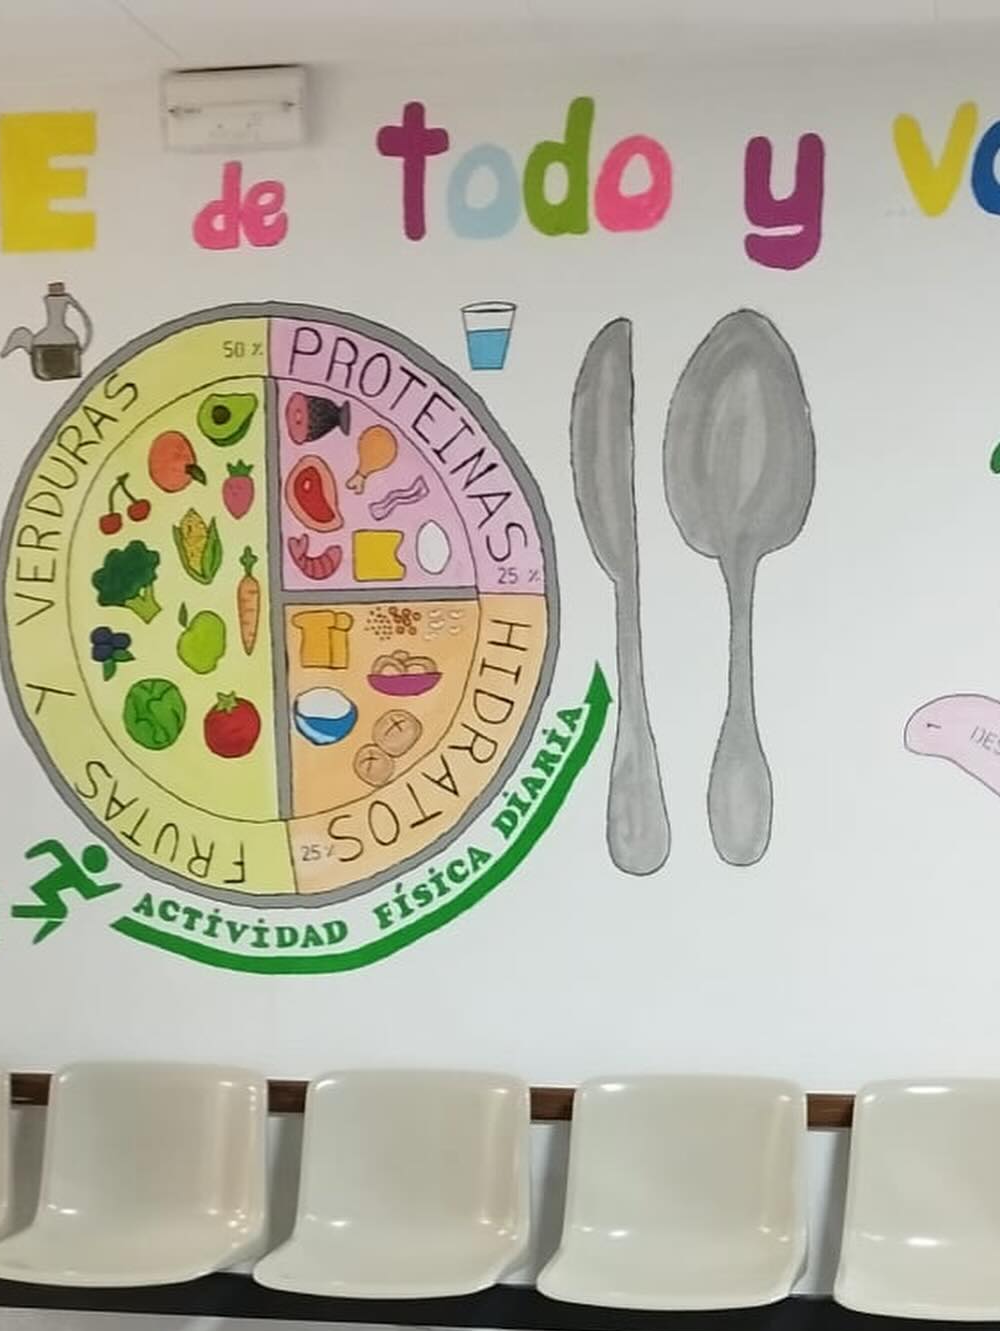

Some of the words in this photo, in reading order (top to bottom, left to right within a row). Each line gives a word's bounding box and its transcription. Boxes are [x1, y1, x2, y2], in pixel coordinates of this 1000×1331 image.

[193, 161, 289, 250] de
[376, 96, 673, 241] todo
[744, 132, 825, 271] y
[13, 373, 139, 626] VERDURAS
[288, 326, 528, 562] PROTEINAS
[25, 682, 77, 715] Y
[327, 618, 532, 863] HIDRATOS
[74, 760, 247, 884] FRUTAS
